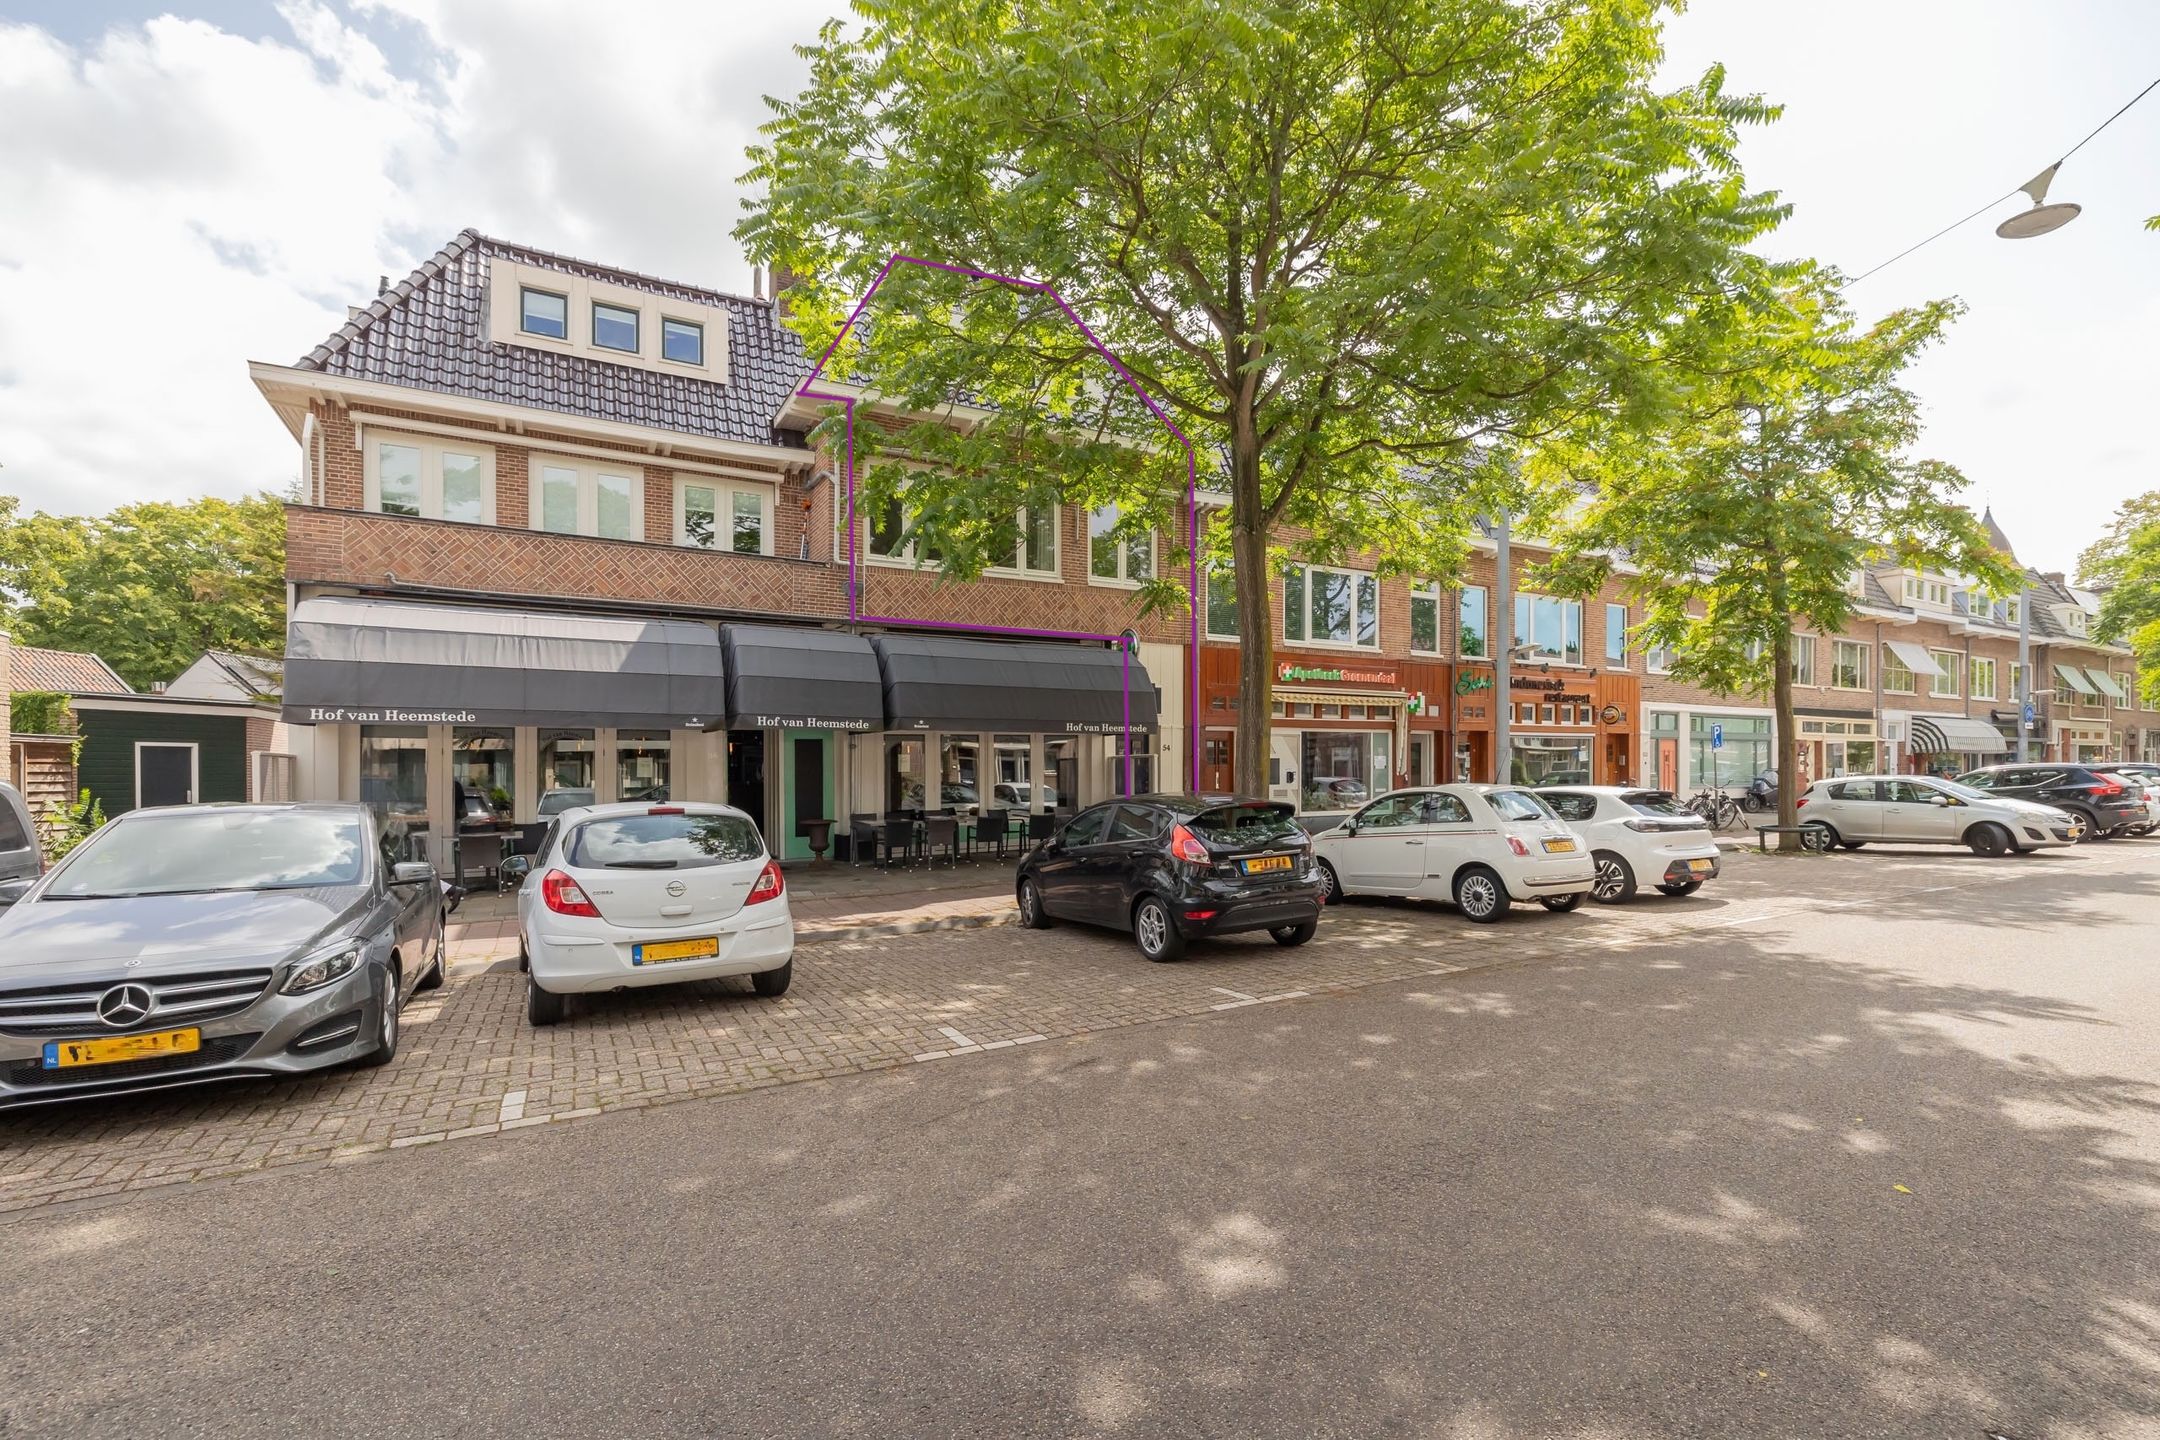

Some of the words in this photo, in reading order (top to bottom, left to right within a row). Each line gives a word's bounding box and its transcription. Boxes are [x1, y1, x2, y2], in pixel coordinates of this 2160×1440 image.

[309, 708, 345, 721] Hof
[347, 711, 379, 721] van
[384, 709, 476, 723] Heemstede
[757, 716, 780, 727] Hof
[781, 718, 804, 728] van
[807, 717, 870, 730] Heemstede
[1066, 722, 1083, 732] Hof
[1102, 723, 1147, 732] Heemtede
[1714, 726, 1720, 739] P
[1162, 744, 1171, 752] 54
[46, 1057, 57, 1065] NL
